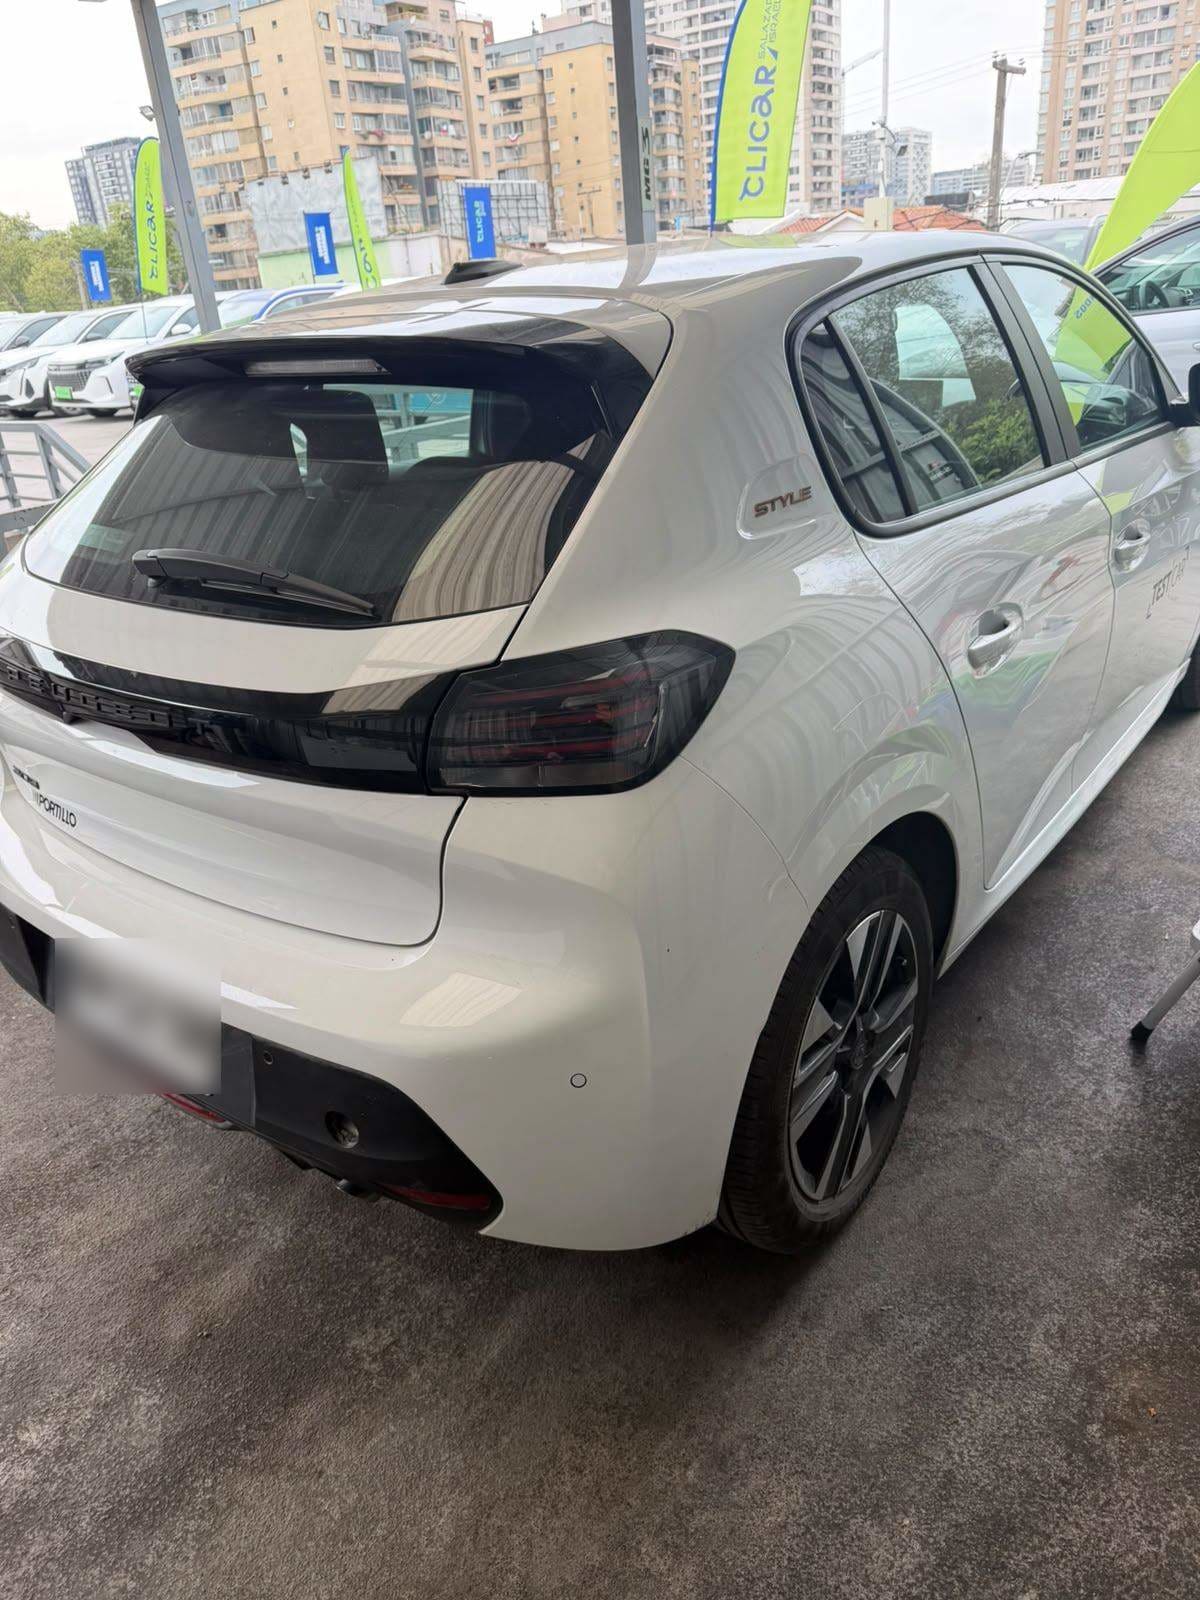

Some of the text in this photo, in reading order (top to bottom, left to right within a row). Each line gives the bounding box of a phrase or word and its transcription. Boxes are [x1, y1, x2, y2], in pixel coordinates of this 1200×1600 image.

[754, 486, 812, 518] STYLE
[1152, 570, 1173, 605] TEST
[39, 794, 77, 828] PORTILLO
